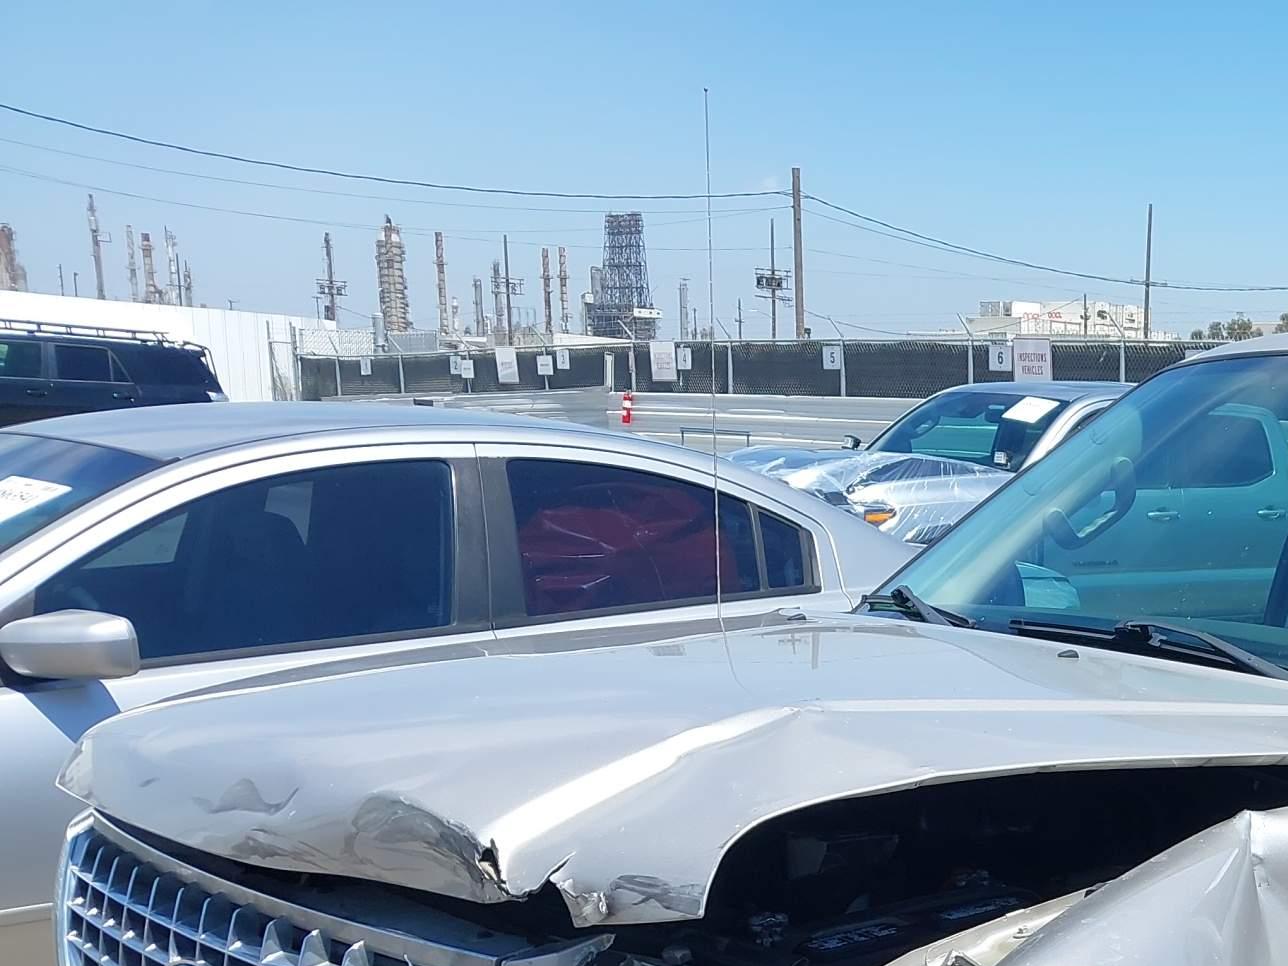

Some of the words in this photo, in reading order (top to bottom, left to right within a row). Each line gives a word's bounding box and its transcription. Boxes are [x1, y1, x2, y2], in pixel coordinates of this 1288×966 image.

[829, 352, 836, 364] 5
[997, 350, 1004, 365] 6
[1017, 353, 1047, 363] INSPECTIONS
[1021, 365, 1044, 376] VEHICLES
